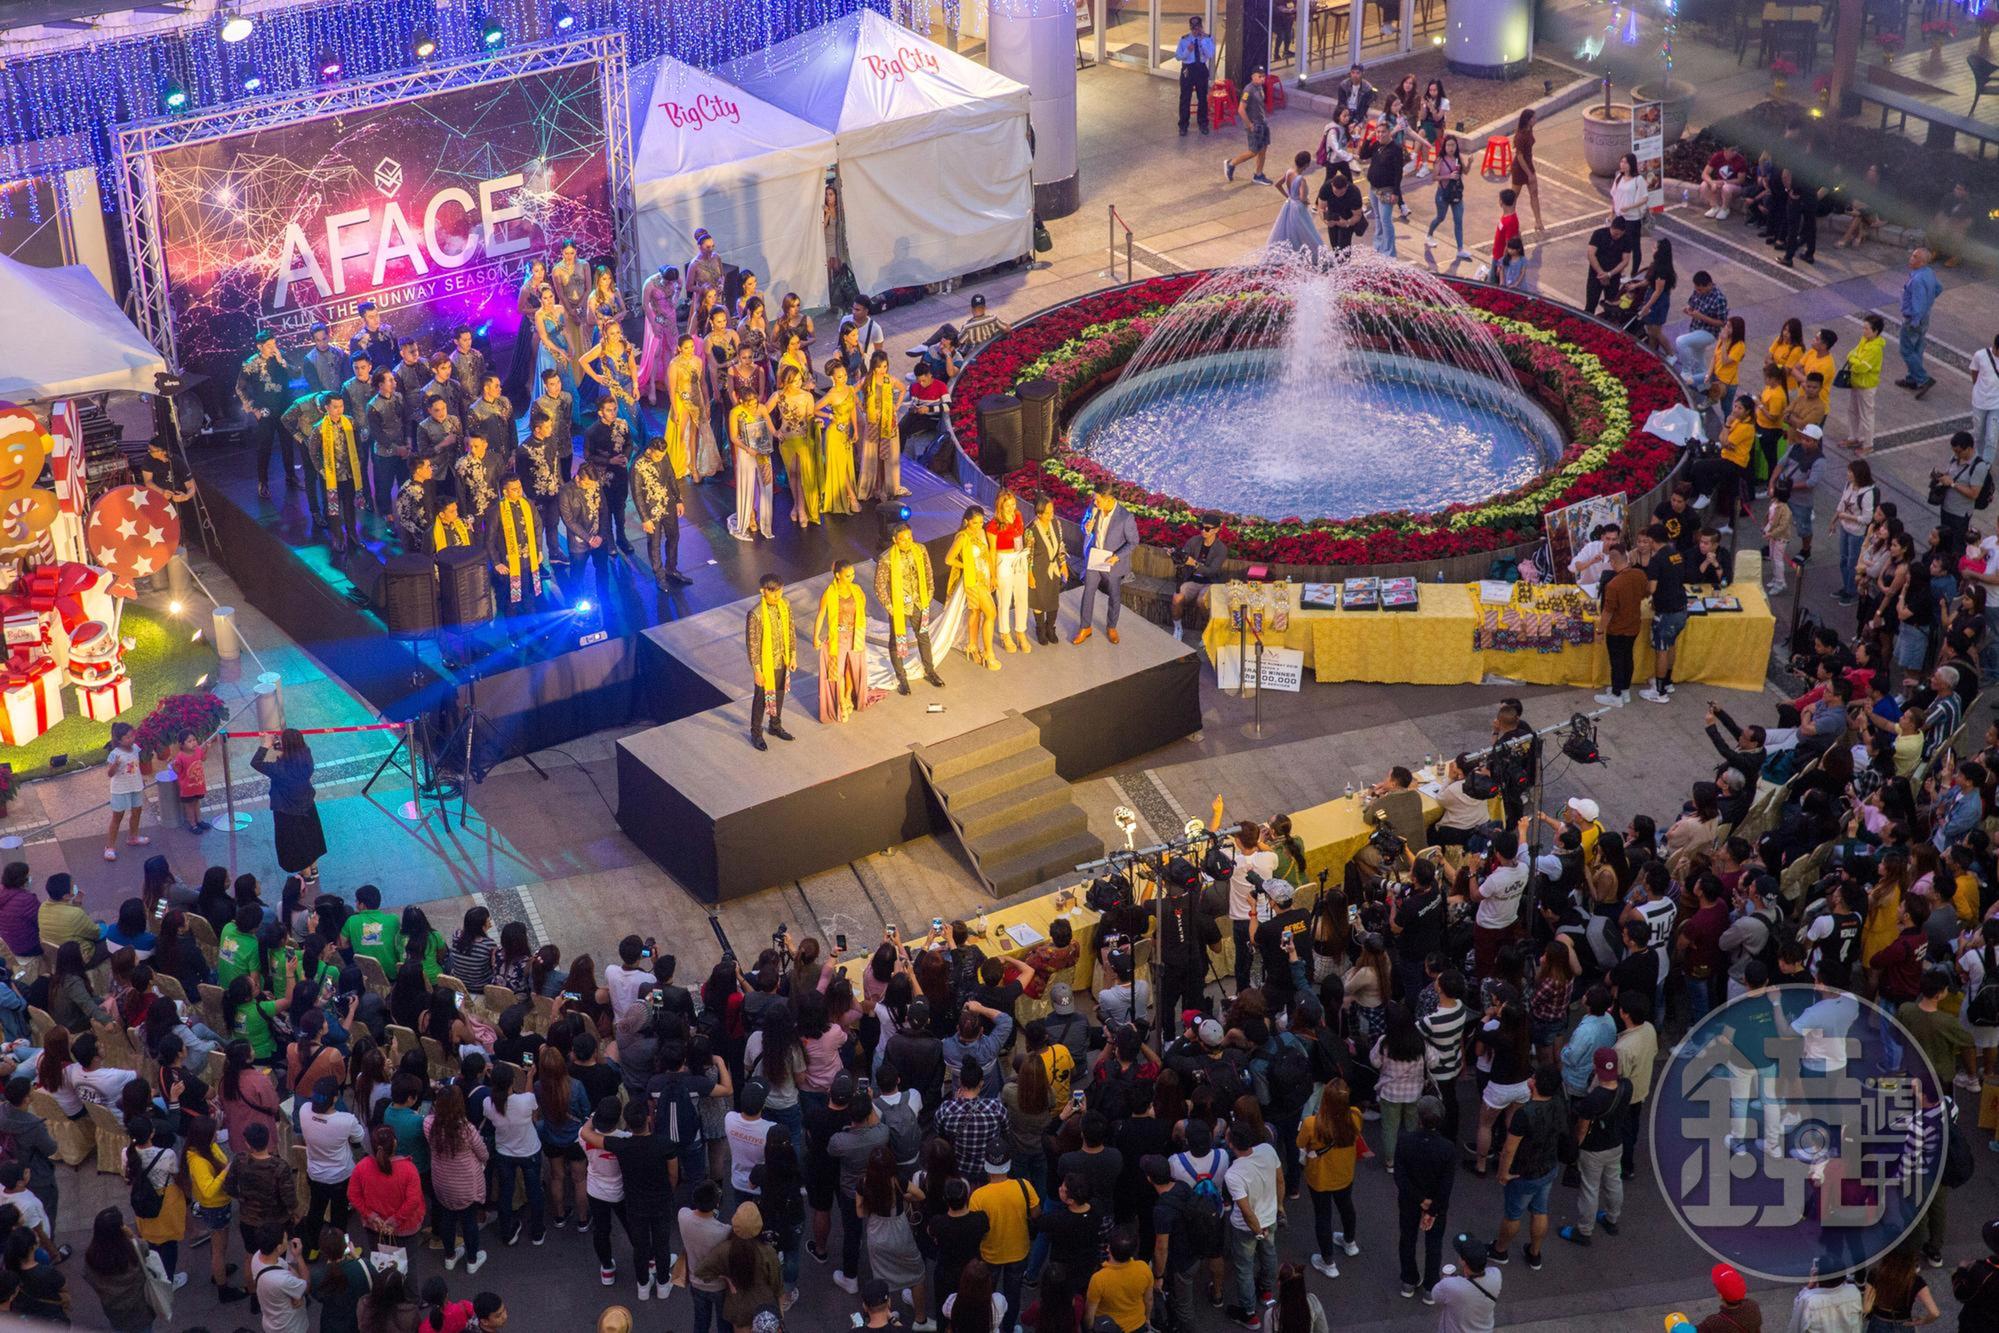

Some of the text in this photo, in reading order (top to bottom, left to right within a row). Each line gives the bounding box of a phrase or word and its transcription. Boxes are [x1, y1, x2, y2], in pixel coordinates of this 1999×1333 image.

[861, 46, 940, 82] BigCity
[657, 93, 741, 131] BigCity
[272, 172, 531, 309] AFACE
[325, 300, 359, 321] THE
[444, 263, 509, 292] SEASON
[1268, 670, 1296, 678] WINNER
